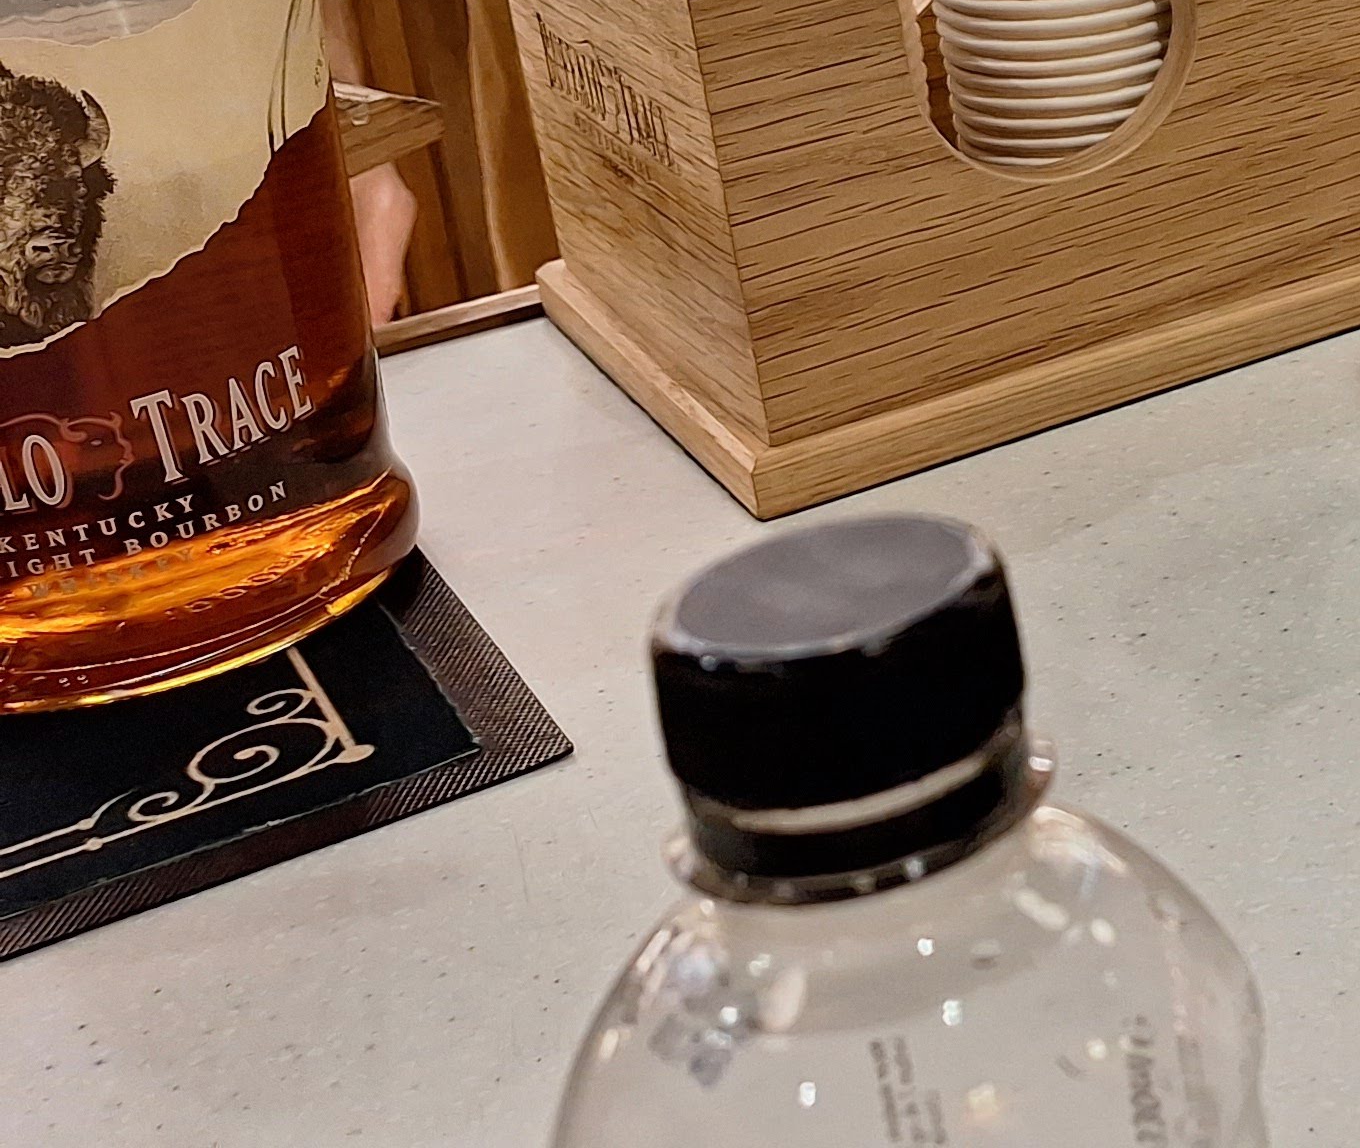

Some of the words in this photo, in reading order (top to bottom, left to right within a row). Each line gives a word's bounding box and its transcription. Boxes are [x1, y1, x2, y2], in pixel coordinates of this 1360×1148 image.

[130, 345, 313, 484] TRACE
[0, 494, 194, 554] KENTUCKY
[123, 481, 288, 556] BOURBON
